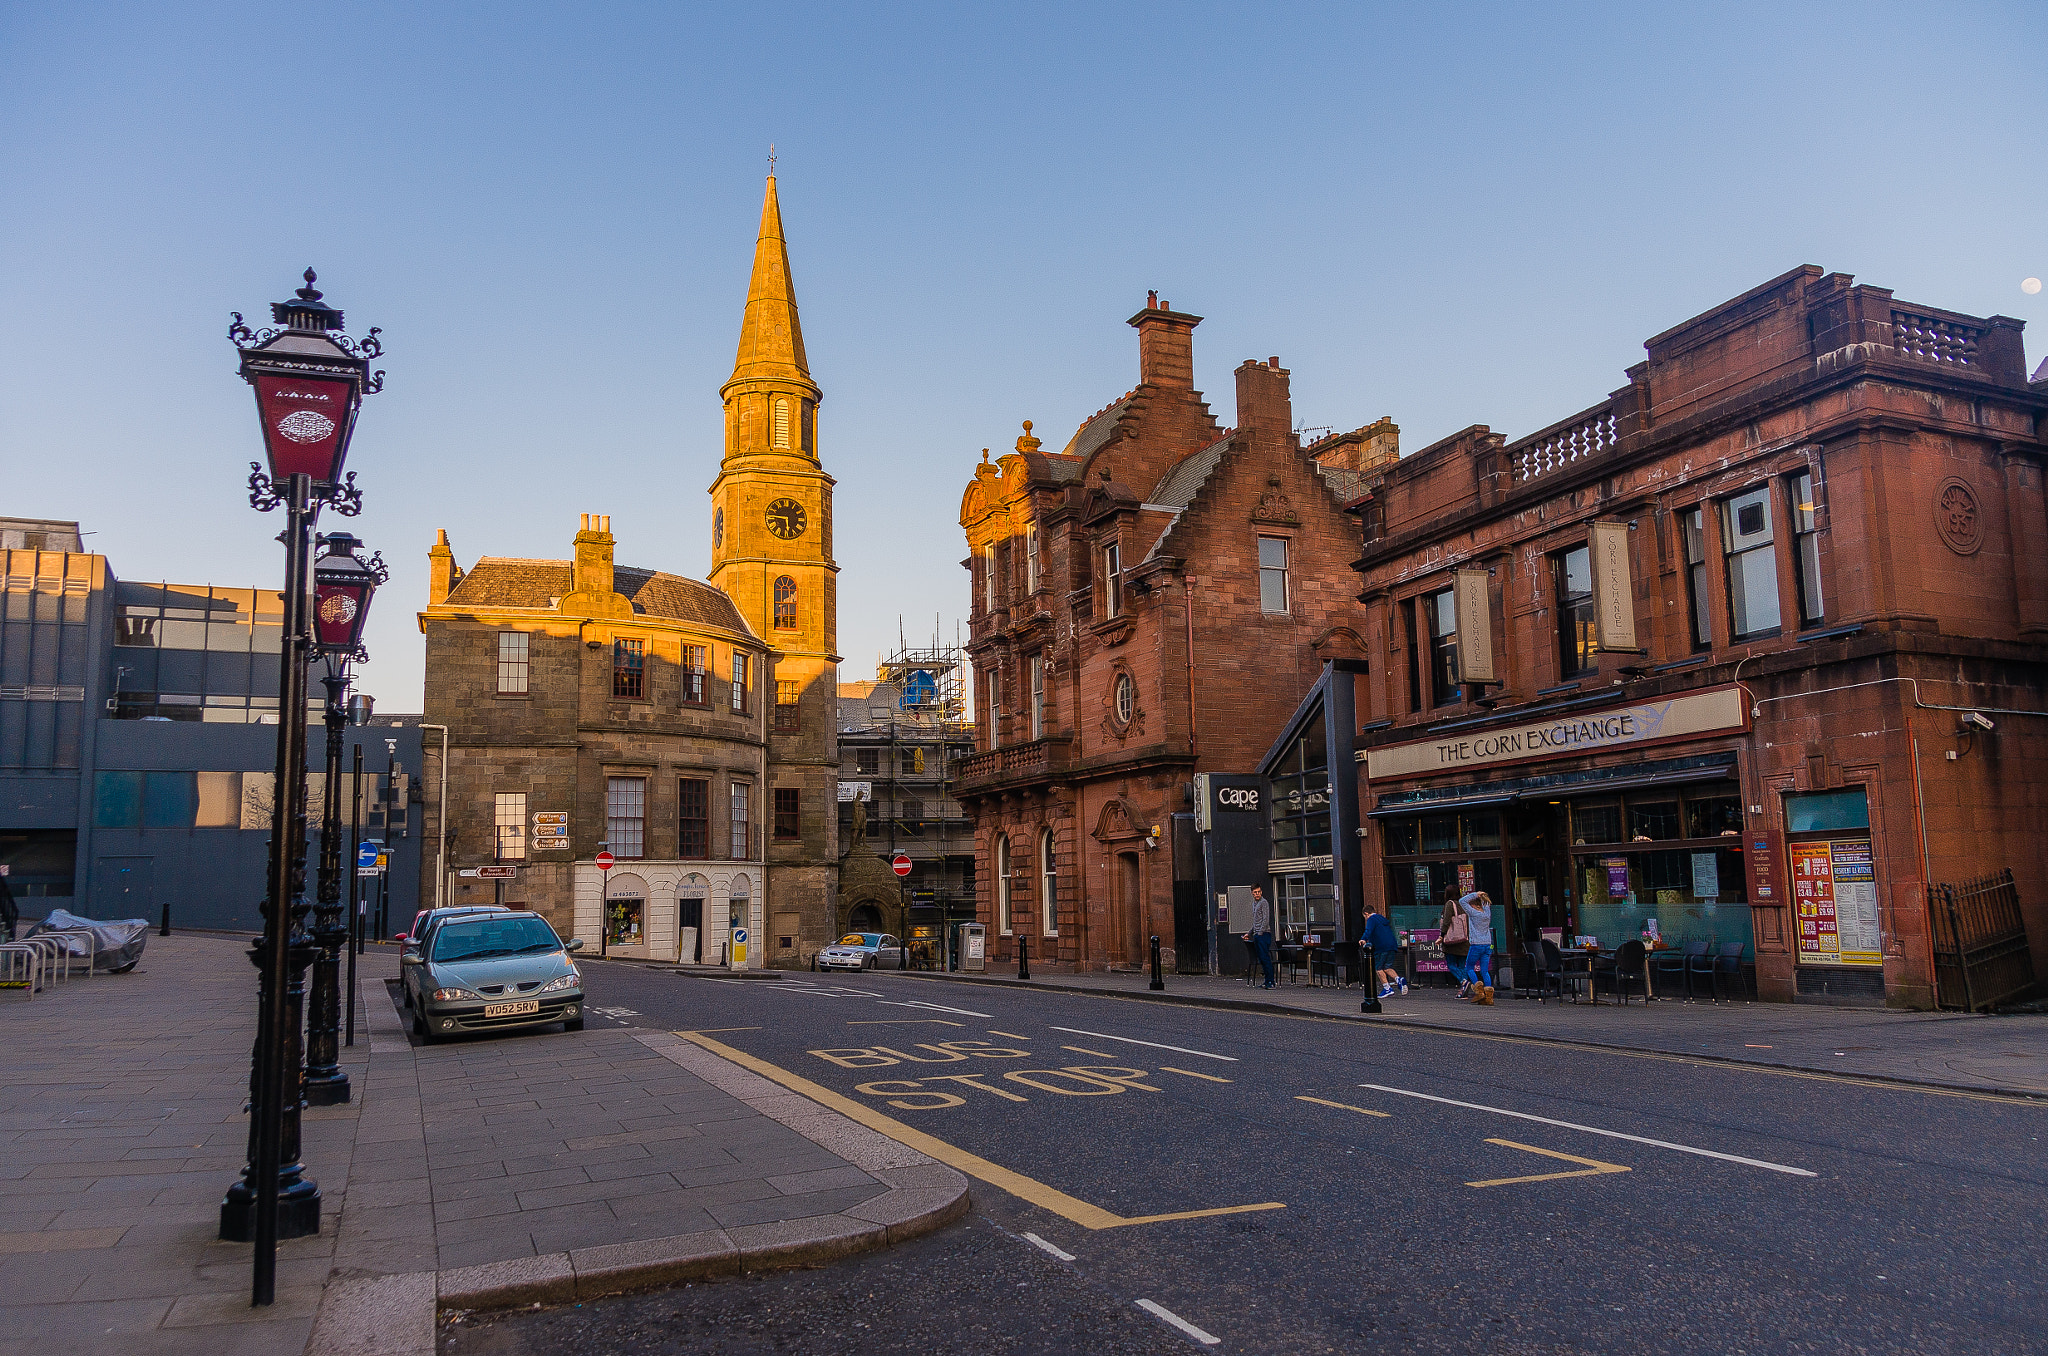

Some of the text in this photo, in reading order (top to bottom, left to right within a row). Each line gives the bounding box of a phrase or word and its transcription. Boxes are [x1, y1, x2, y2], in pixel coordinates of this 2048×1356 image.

[1608, 535, 1622, 628] CORN EXCHANGE
[1469, 581, 1481, 662] CORN EXCHANGE
[1437, 715, 1635, 762] THE CORN EXCHANGE
[1218, 787, 1259, 808] Cape
[1244, 803, 1258, 811] BAR
[1813, 867, 1829, 875] £2.49
[683, 890, 704, 898] FLORIST
[1420, 942, 1434, 951] Pool
[1820, 935, 1837, 943] FREE
[489, 1001, 535, 1015] VO52 SRV
[805, 1040, 1032, 1069] BUS
[854, 1065, 1163, 1111] STOP
